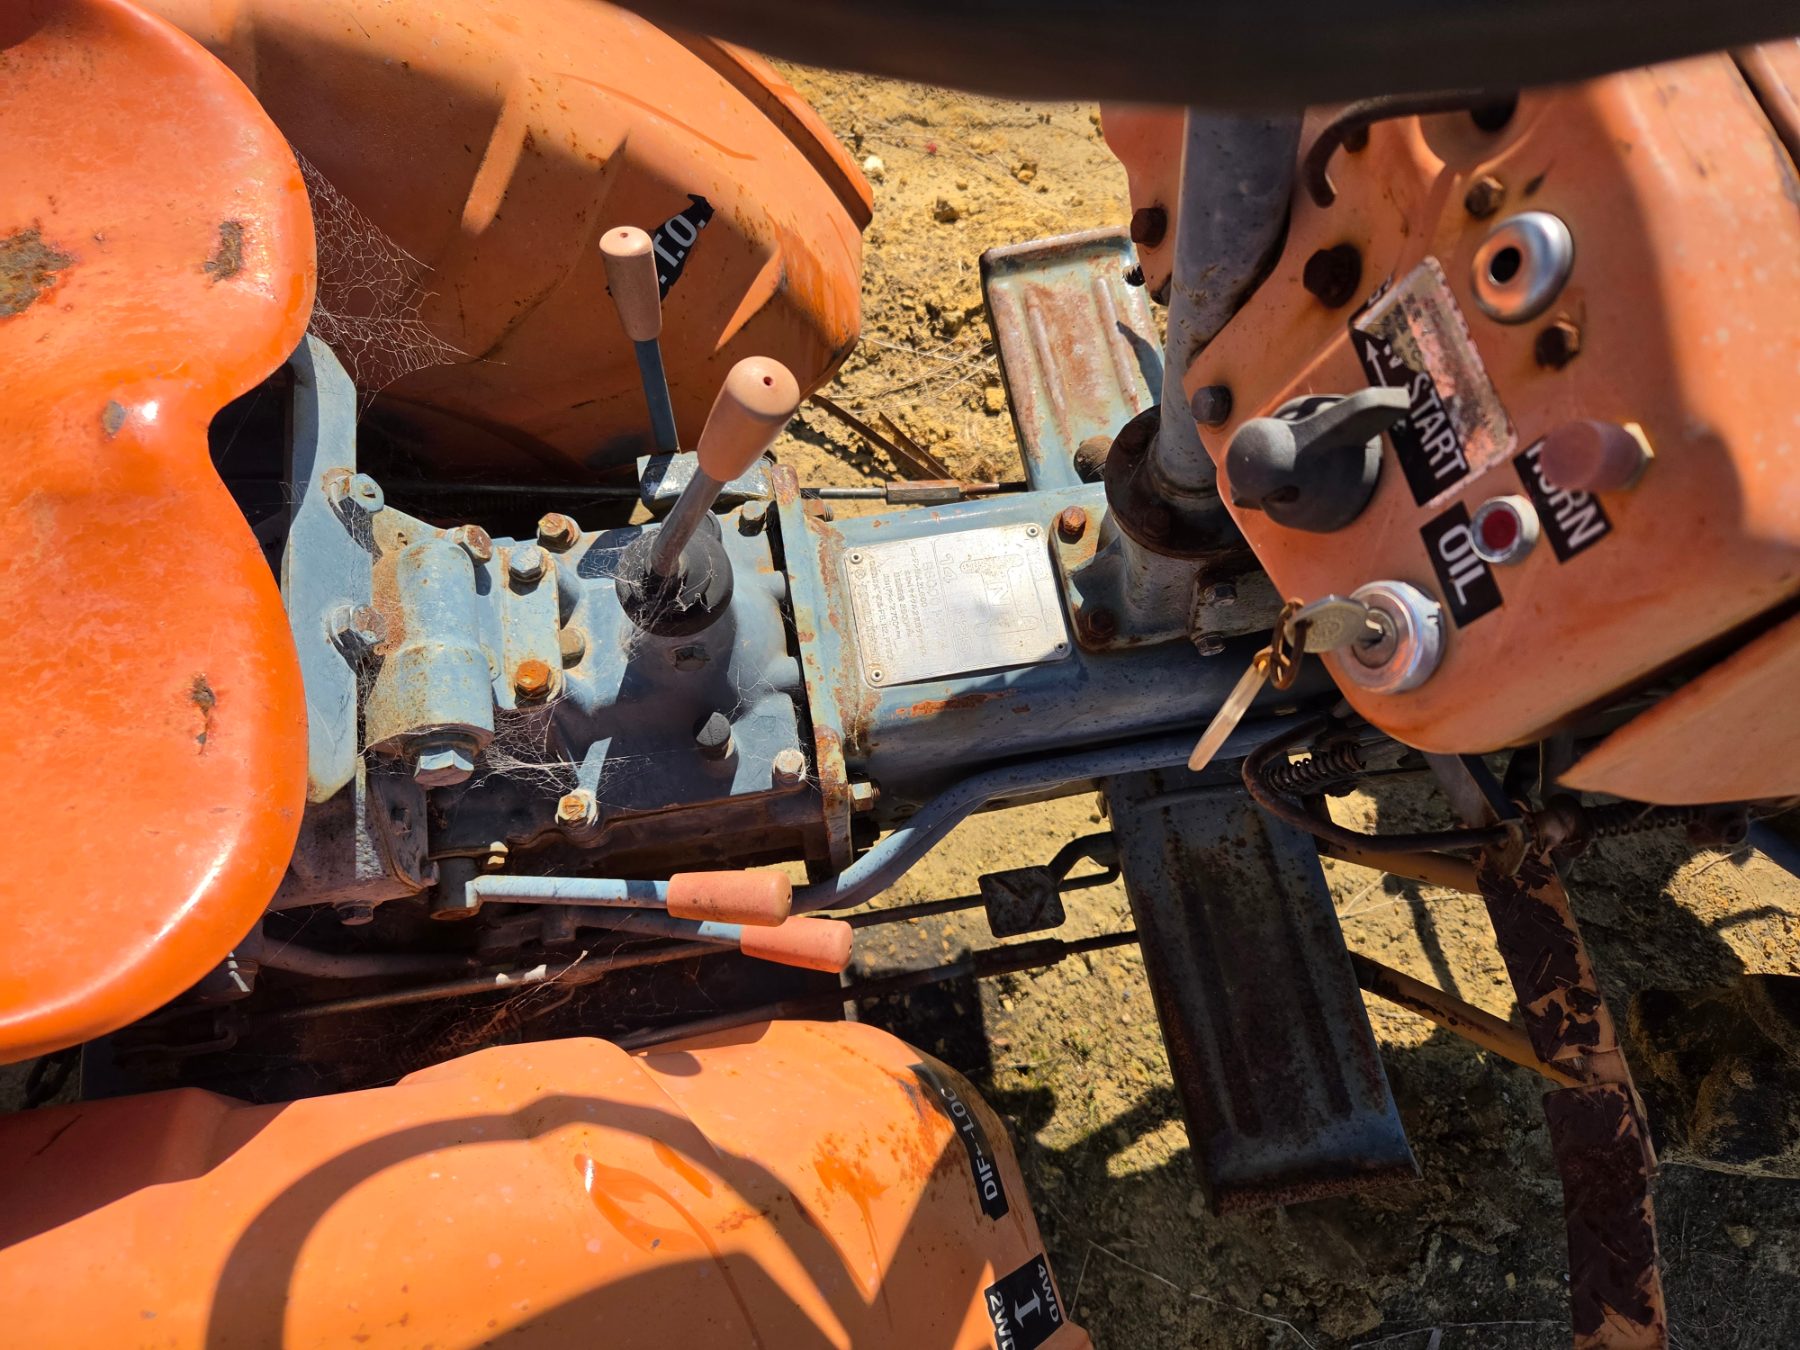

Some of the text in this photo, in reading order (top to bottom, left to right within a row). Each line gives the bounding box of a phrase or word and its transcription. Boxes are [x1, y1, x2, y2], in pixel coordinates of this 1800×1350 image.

[653, 214, 706, 285] .T.O.
[1408, 371, 1467, 481] START
[1438, 523, 1486, 606] OIL
[1037, 1263, 1059, 1322] 4WD
